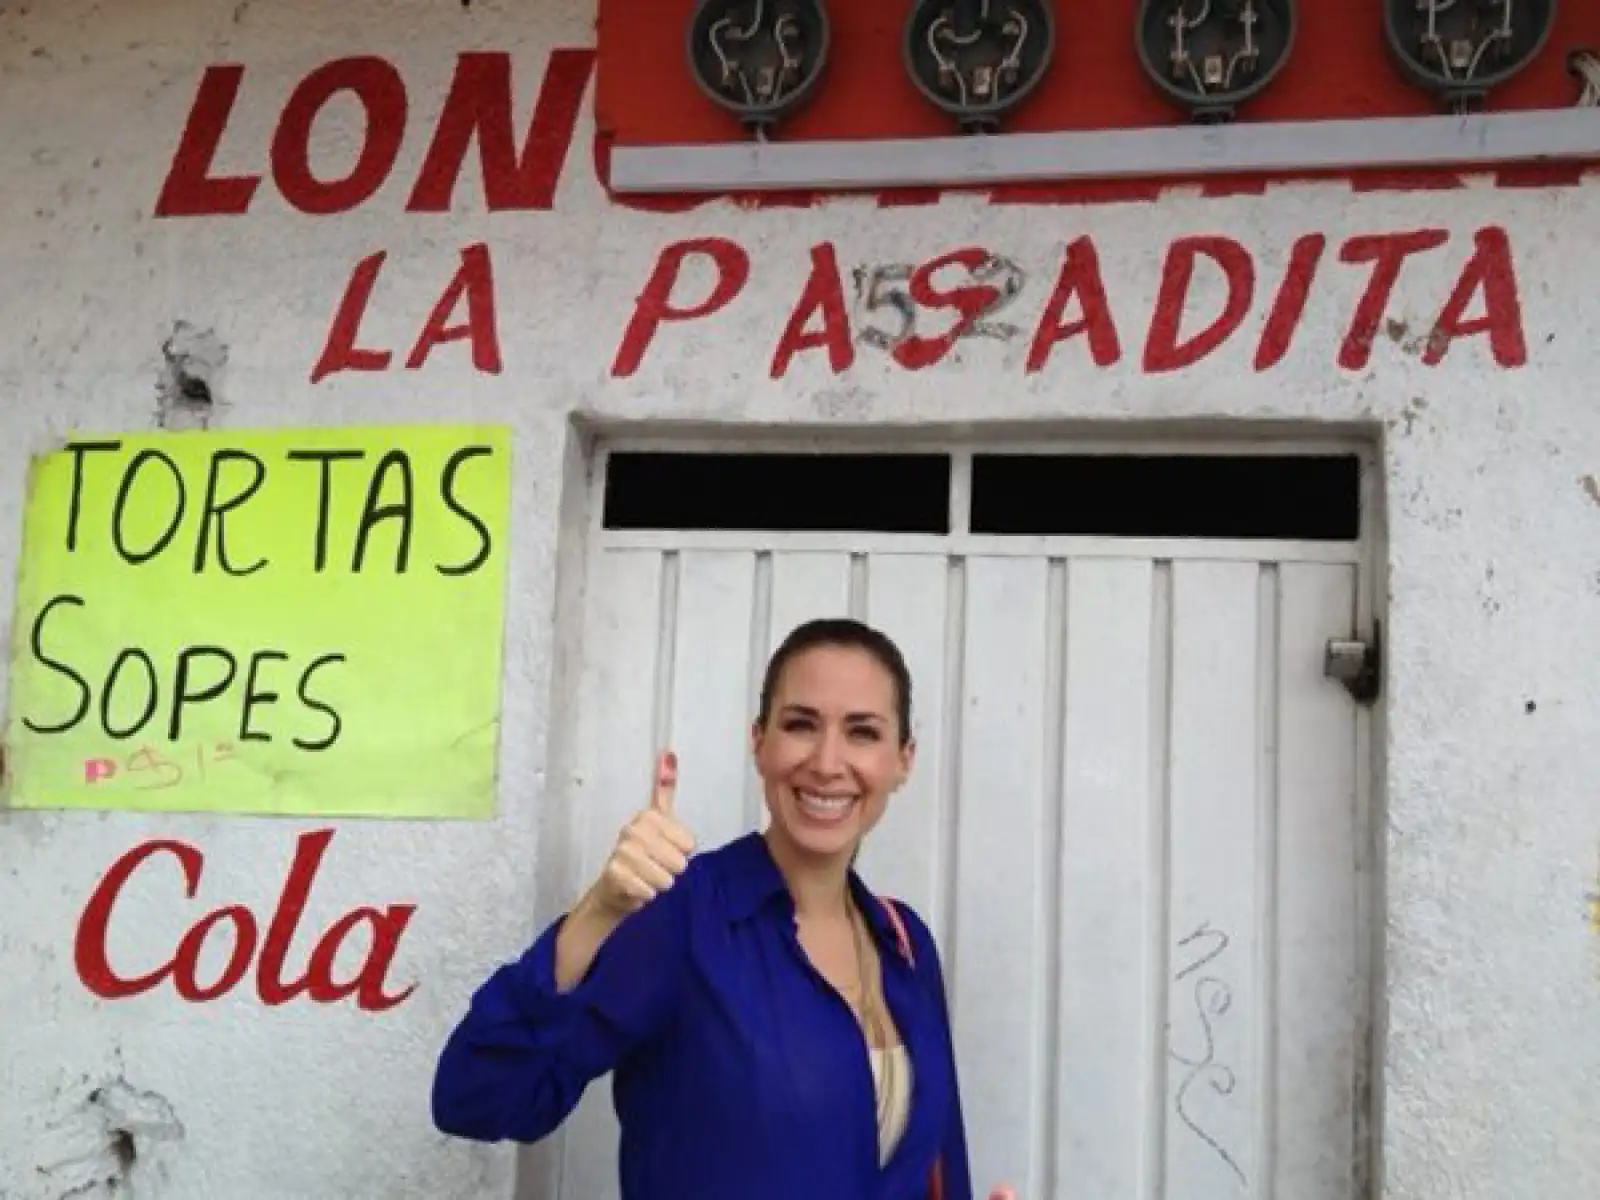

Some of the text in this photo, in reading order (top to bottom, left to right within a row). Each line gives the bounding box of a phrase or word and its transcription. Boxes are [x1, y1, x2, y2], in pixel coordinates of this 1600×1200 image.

[310, 225, 1527, 383] LA PASADITA
[63, 440, 494, 576] TORTAS
[22, 594, 347, 751] SOPES
[73, 827, 420, 1012] Cola
